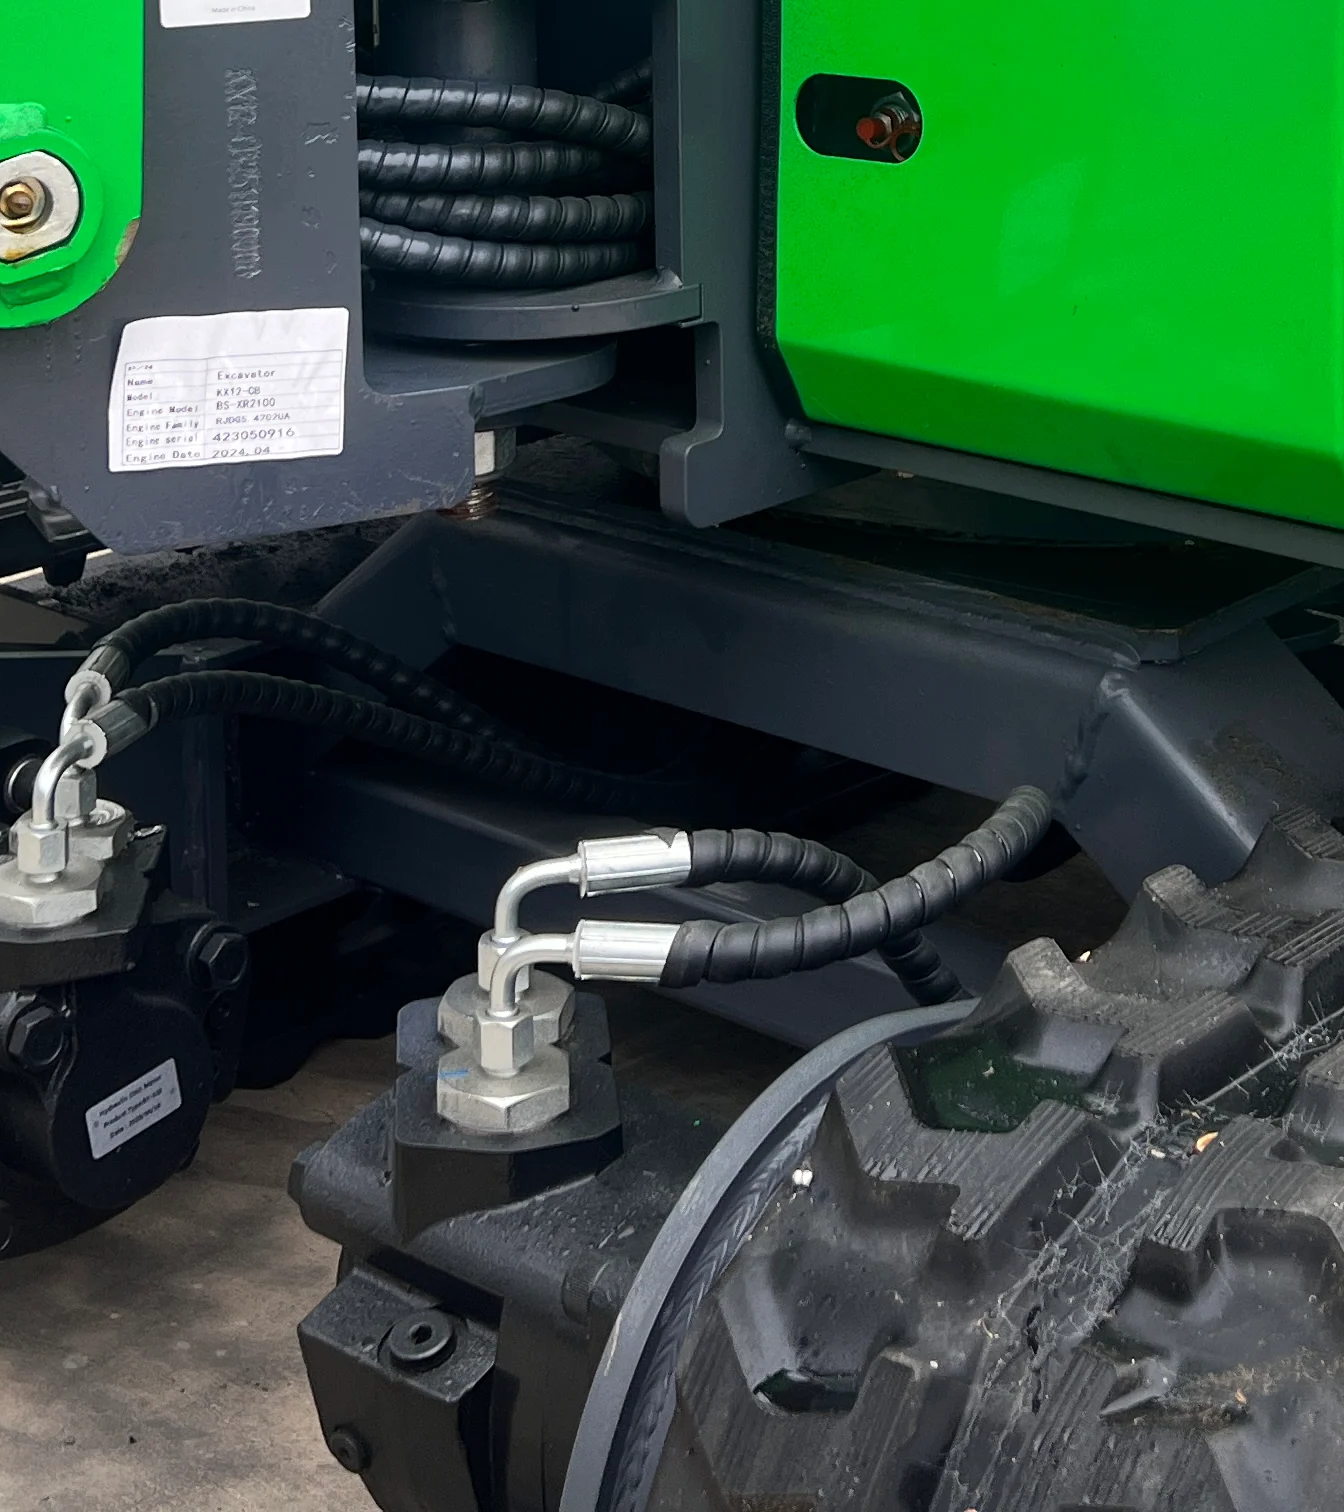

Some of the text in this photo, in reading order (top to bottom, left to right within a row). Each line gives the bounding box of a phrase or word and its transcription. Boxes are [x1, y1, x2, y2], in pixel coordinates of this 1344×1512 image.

[217, 370, 275, 380] Excavator
[127, 386, 261, 401] Model KX12-CB
[127, 398, 276, 417] Engine Model BS-XR2100
[126, 423, 160, 432] Engine
[166, 420, 199, 429] Family
[126, 427, 295, 447] Engine serial 423050916
[126, 453, 166, 464] Engine
[172, 450, 201, 458] Date
